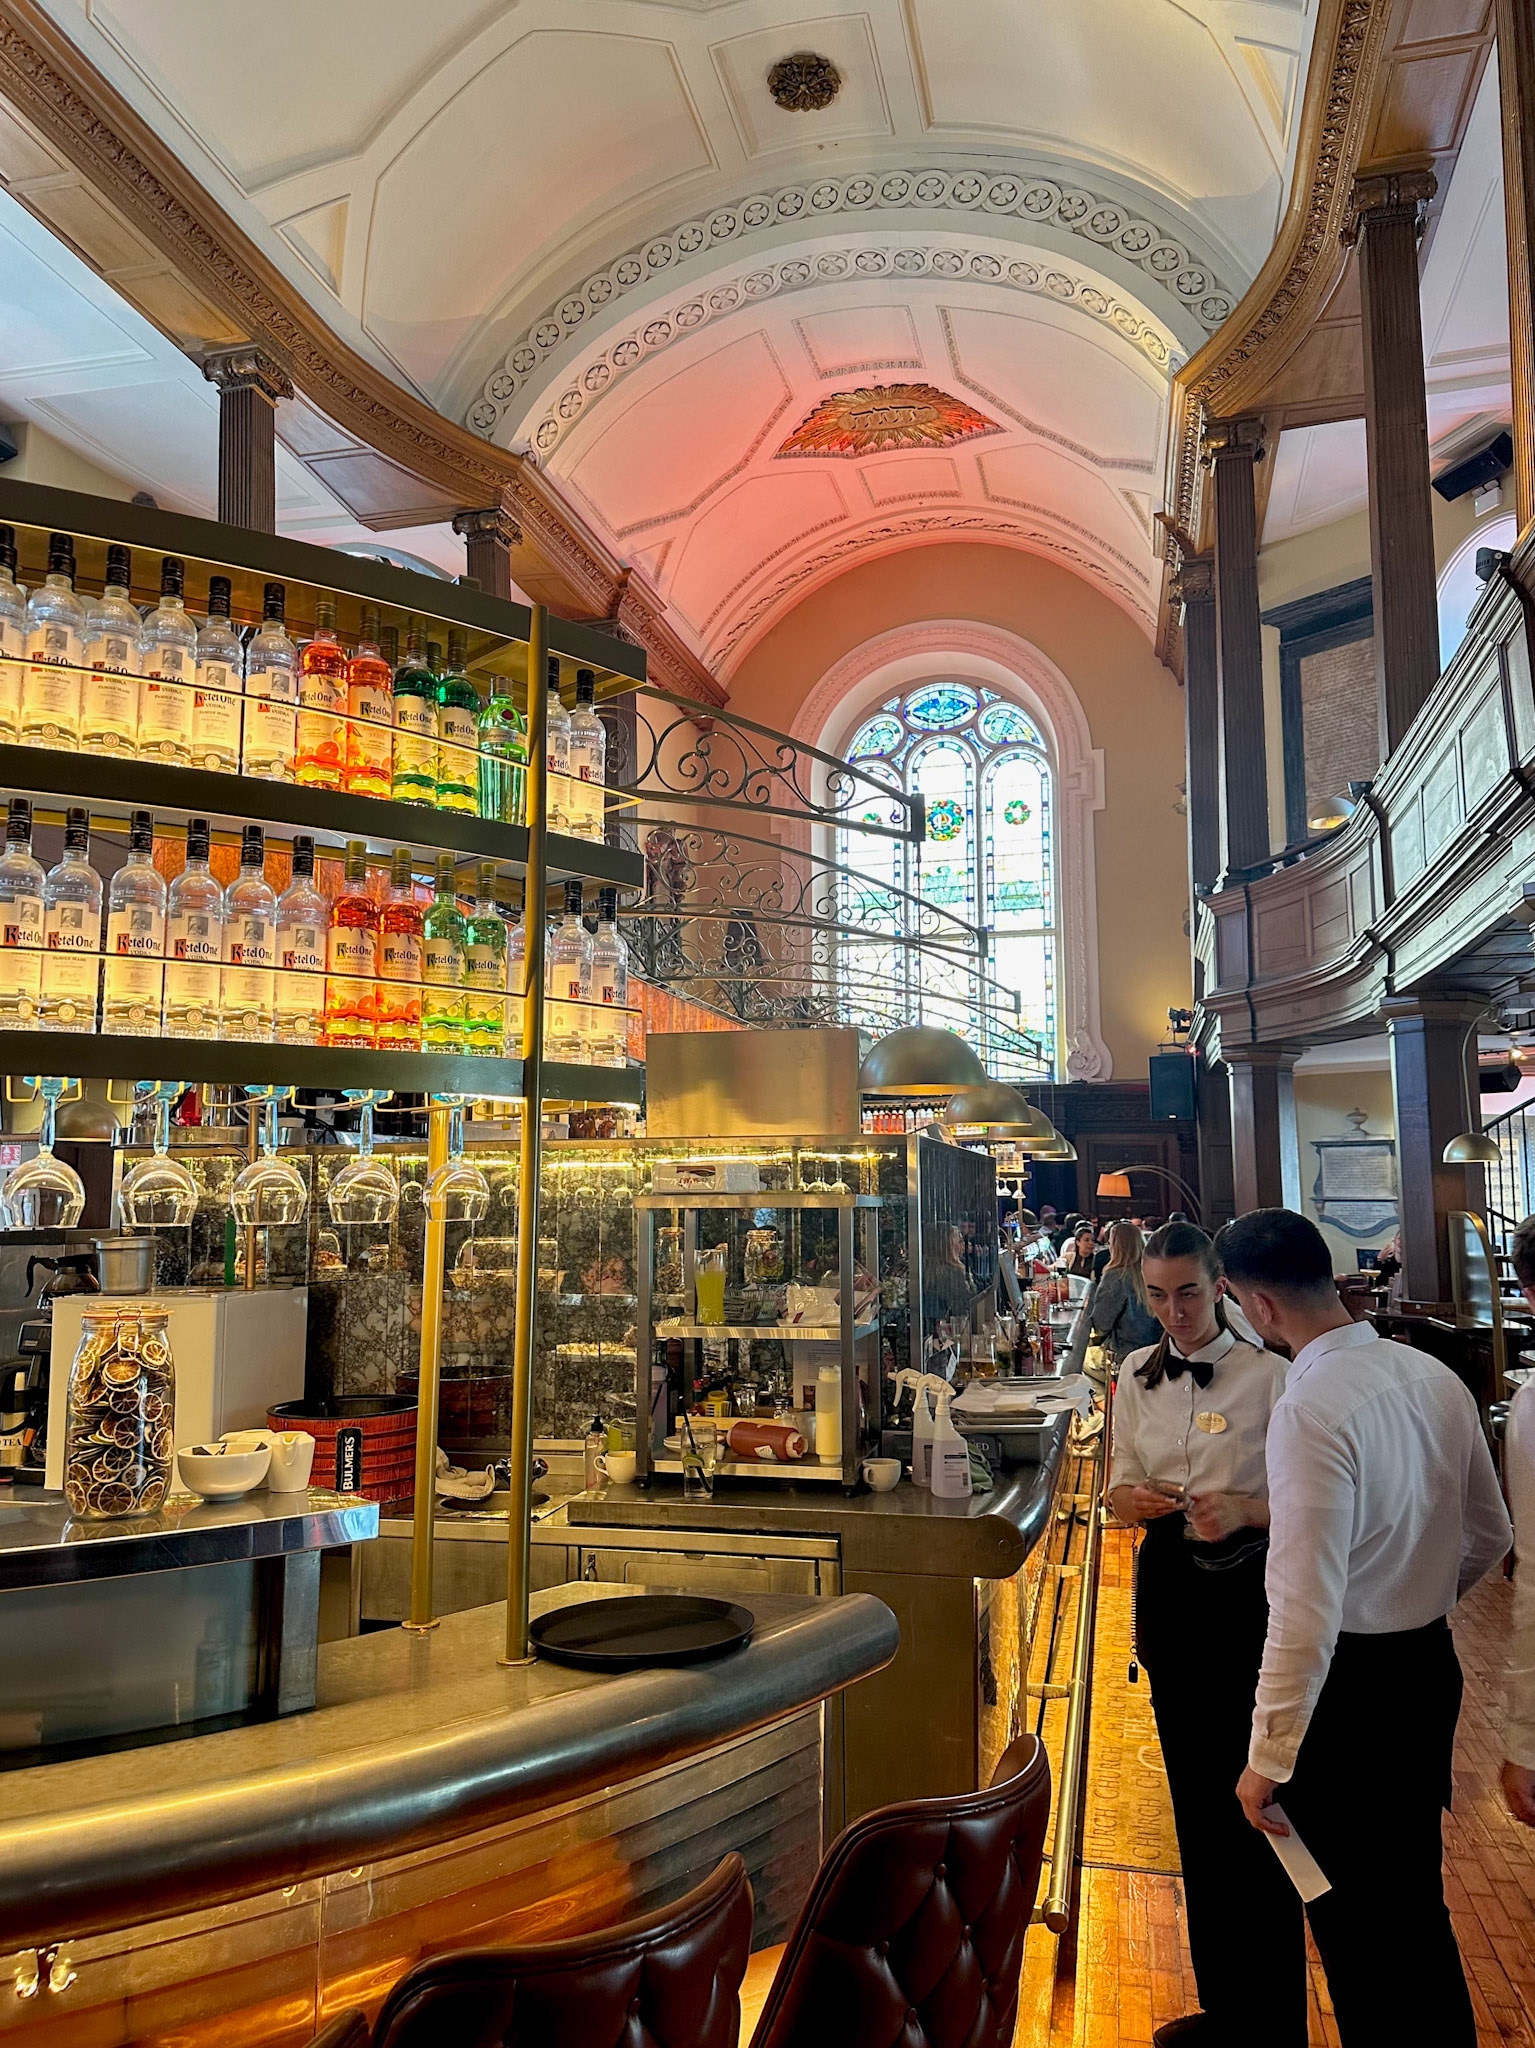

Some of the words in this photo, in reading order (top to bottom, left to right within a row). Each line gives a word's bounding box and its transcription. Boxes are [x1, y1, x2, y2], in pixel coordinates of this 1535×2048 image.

[317, 691, 332, 703] One
[361, 702, 381, 716] Ketel
[399, 711, 420, 724] Ketel
[420, 713, 432, 723] One
[445, 722, 465, 736] Ketel
[580, 767, 600, 779] Ketel
[6, 927, 33, 944] Ketel
[50, 933, 74, 948] Ketel
[76, 935, 93, 948] One
[118, 935, 145, 951] Ketel
[146, 938, 161, 951] One
[175, 940, 201, 956] Ketel
[202, 943, 218, 956] One
[232, 945, 258, 961] Ketel
[259, 948, 273, 961] One
[337, 943, 358, 957] Ketel
[359, 945, 372, 955] One
[385, 948, 405, 962] Ketel
[406, 950, 419, 962] One
[284, 952, 309, 968] Ketel
[310, 955, 323, 967] One
[427, 954, 447, 968] Ketel
[448, 956, 460, 966] One
[468, 959, 487, 973] Ketel
[488, 961, 500, 971] One
[570, 983, 590, 999] Ketel
[604, 987, 623, 1003] Ketel
[3, 1438, 22, 1447] TEA
[343, 1436, 355, 1491] BULMERS
[1092, 1745, 1123, 1799] CHURCH
[1130, 1797, 1162, 1859] CHURCH
